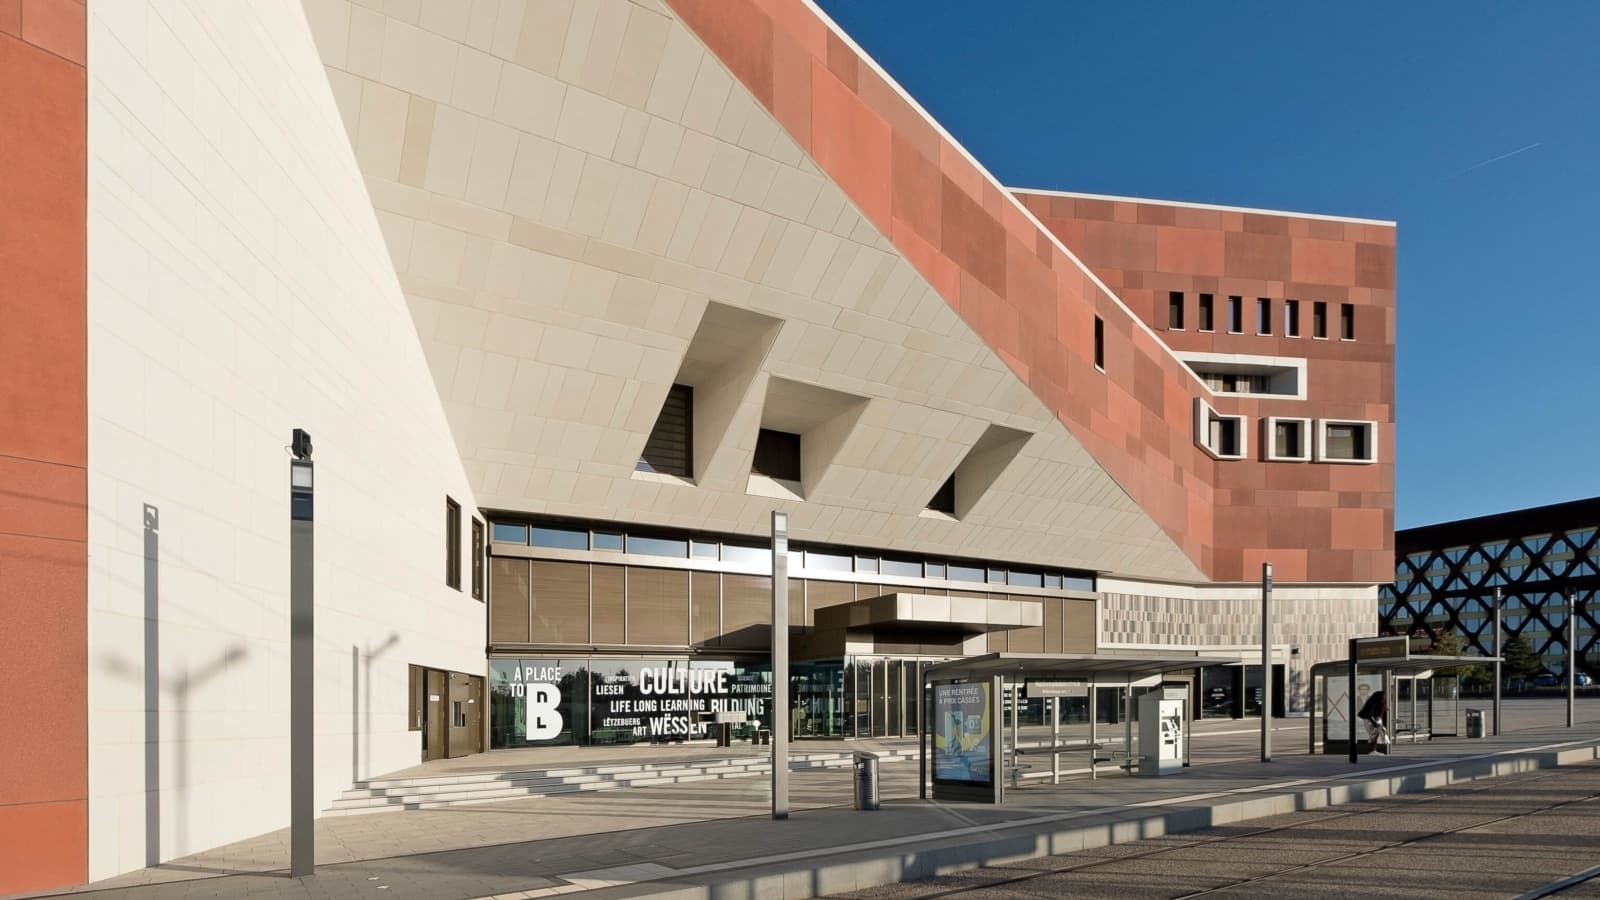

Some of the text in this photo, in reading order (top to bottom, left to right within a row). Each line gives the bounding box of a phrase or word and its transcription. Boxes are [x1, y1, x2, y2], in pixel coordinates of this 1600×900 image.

[514, 666, 561, 681] A PLACE
[640, 667, 728, 695] CULTURE
[510, 683, 524, 697] TO
[596, 685, 624, 695] LIESEN
[731, 684, 772, 694] PATRIMOINE
[610, 699, 705, 713] LIFE LONG LEARNING
[632, 726, 647, 736] ART
